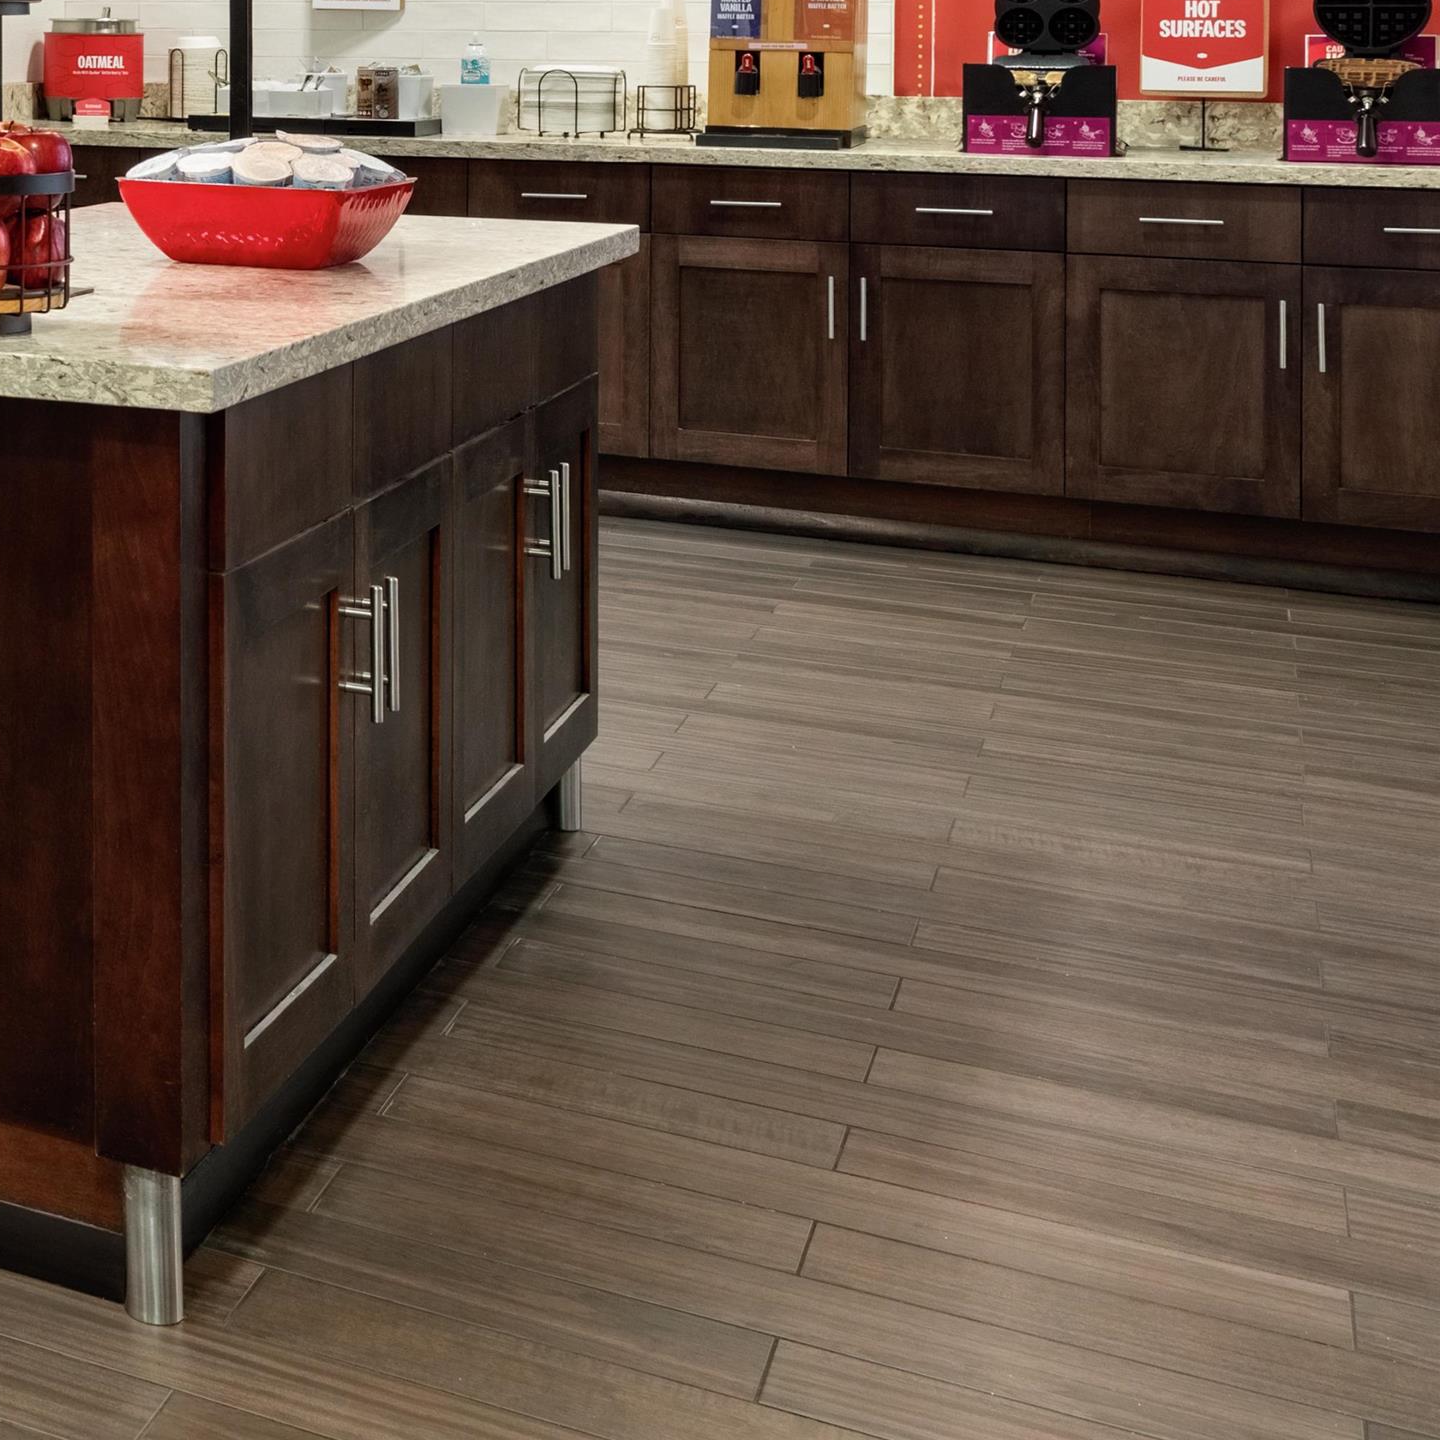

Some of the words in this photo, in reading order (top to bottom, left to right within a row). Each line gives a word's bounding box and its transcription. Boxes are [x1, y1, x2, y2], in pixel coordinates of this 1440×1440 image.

[720, 3, 753, 13] VANILLA
[1184, 0, 1221, 18] HOT
[1159, 20, 1246, 38] SURFACES
[77, 55, 125, 69] OATMEAL
